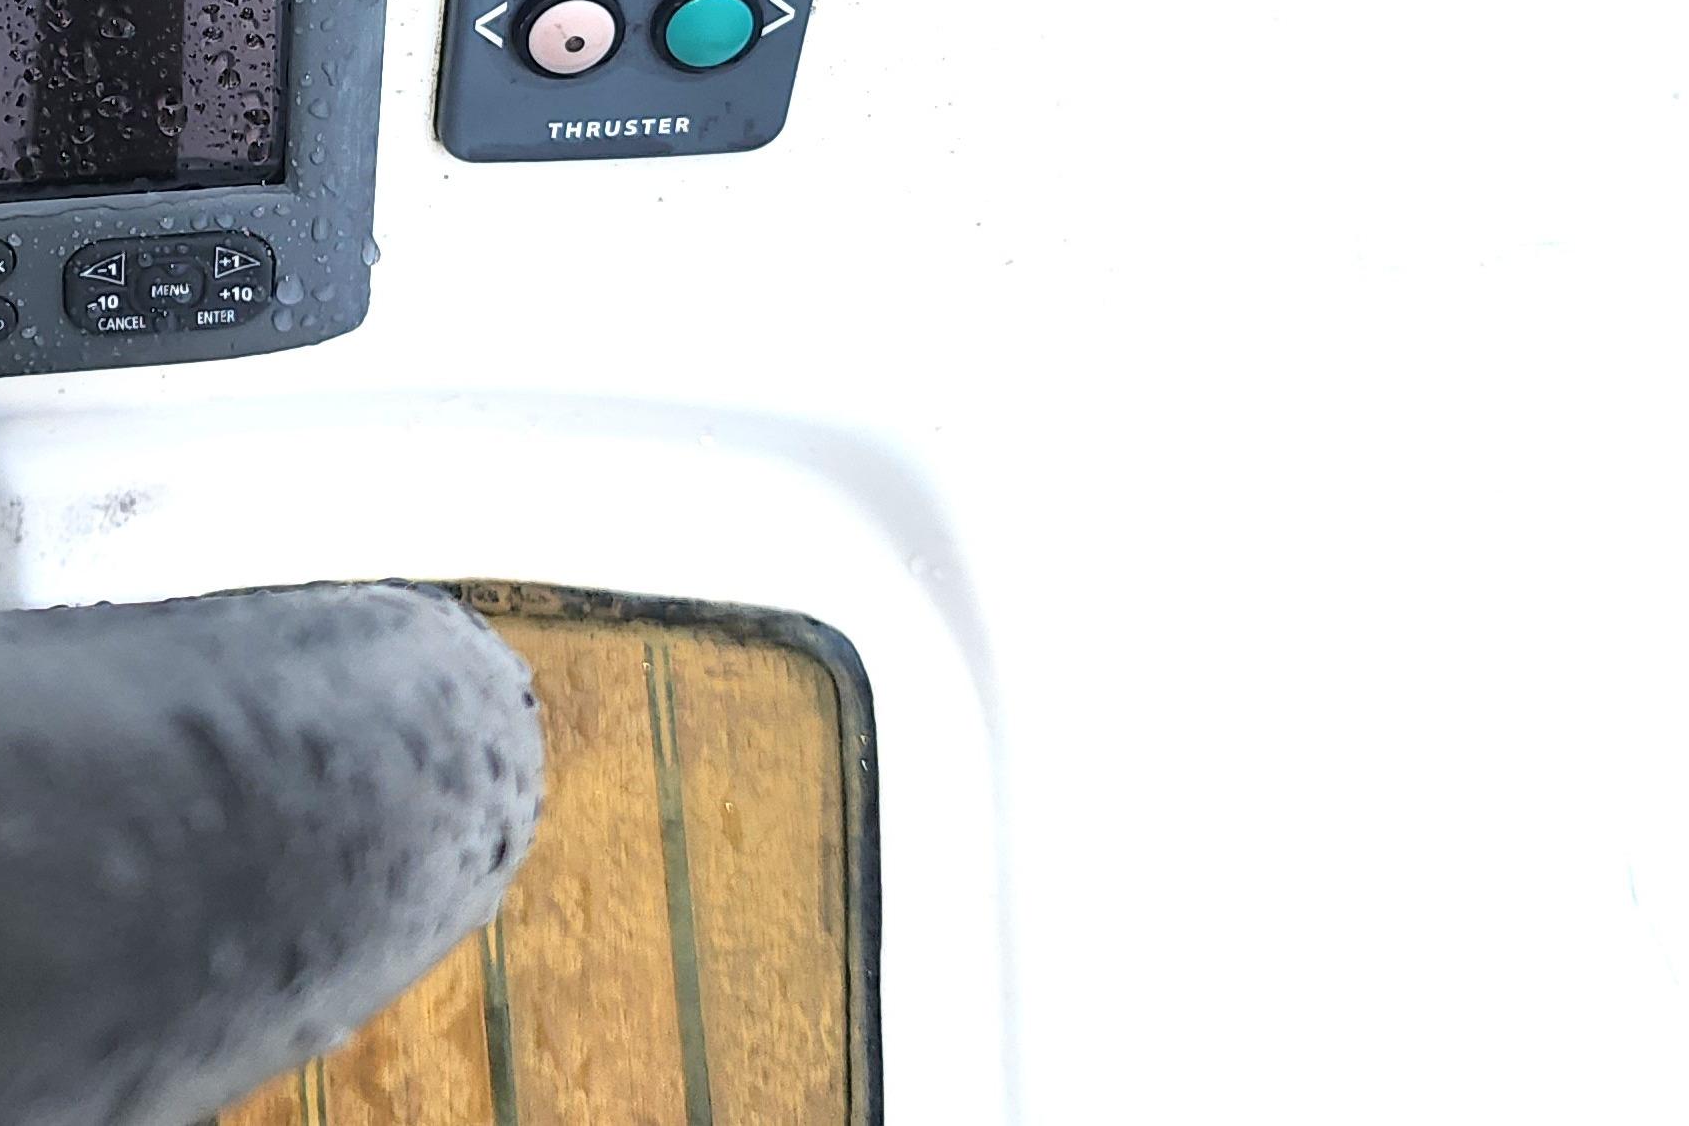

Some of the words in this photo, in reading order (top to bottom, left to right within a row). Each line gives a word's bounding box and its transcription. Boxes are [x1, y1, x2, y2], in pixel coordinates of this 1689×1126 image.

[548, 117, 690, 139] THRUSTER
[151, 283, 190, 298] MENU
[219, 286, 253, 302] +10
[97, 315, 147, 332] CANCEL
[197, 309, 235, 325] ENTER
